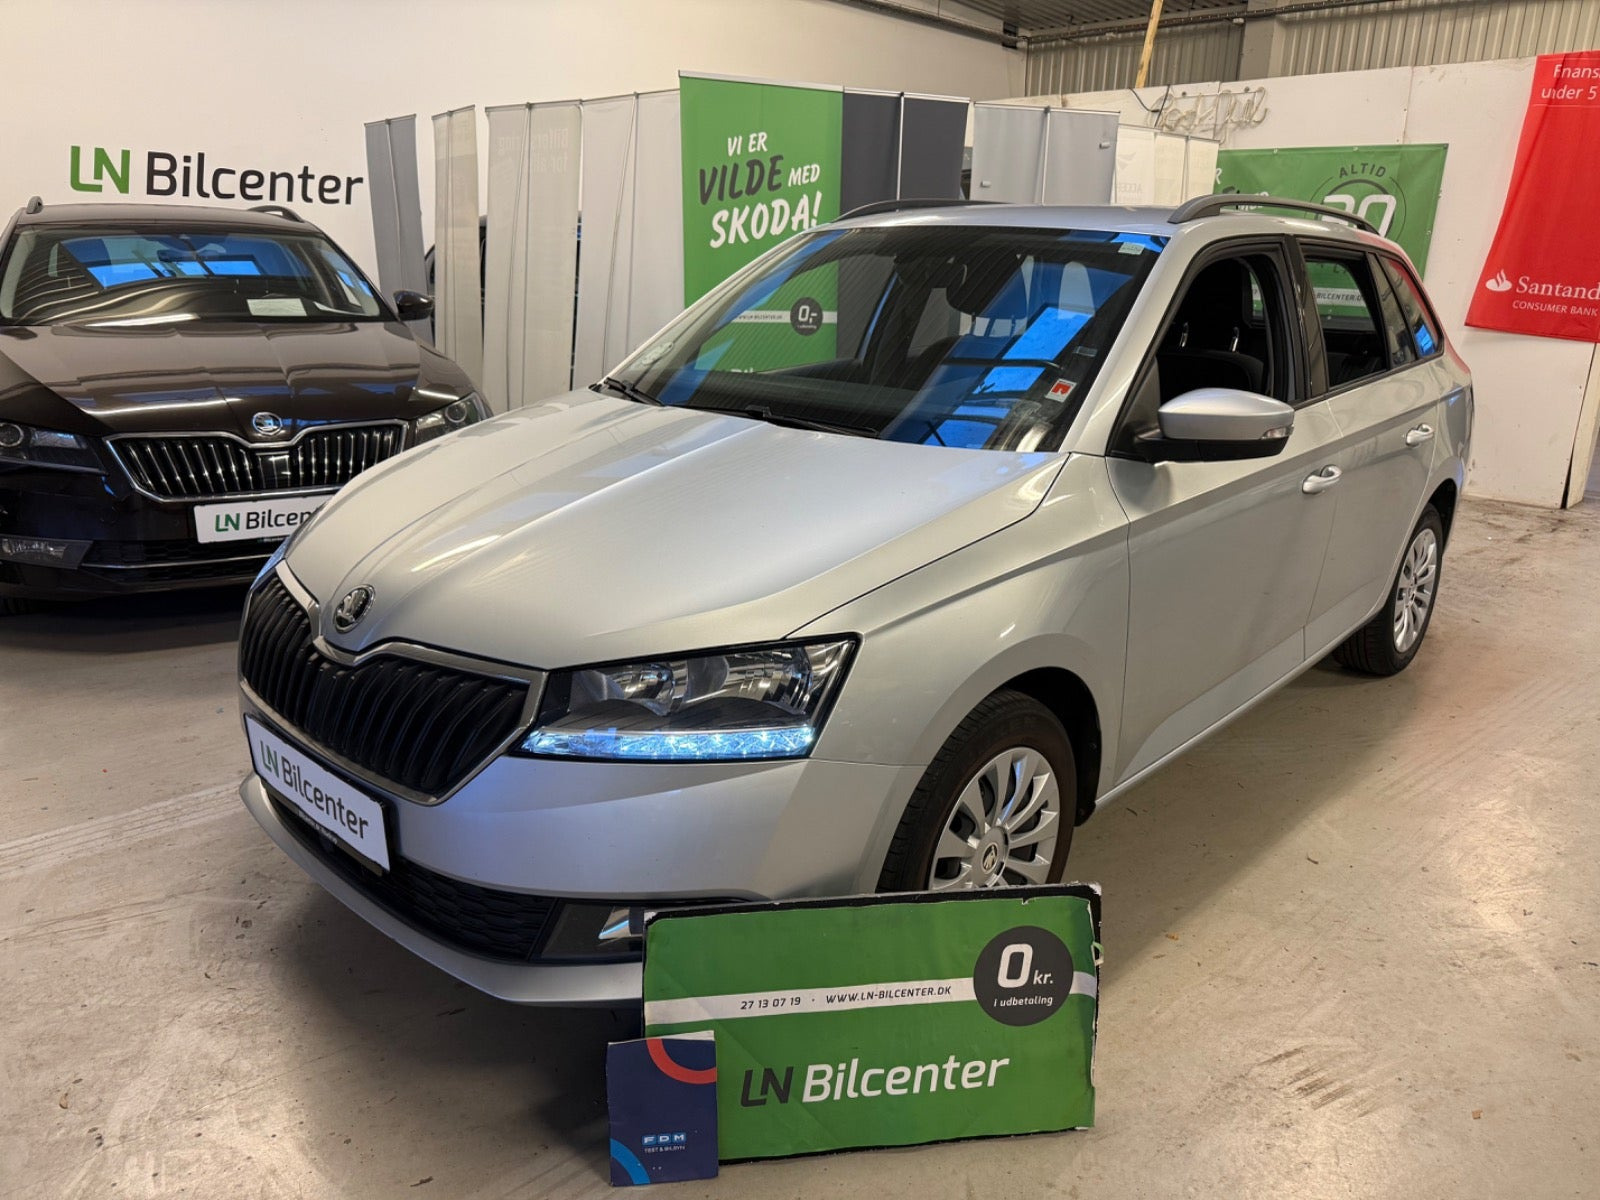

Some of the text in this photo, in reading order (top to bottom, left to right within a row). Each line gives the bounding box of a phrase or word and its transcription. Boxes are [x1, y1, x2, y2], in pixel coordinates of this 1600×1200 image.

[1553, 64, 1600, 79] Fnans
[1587, 85, 1598, 100] 5
[727, 131, 768, 157] VI ER
[70, 145, 364, 205] LN Bilcenter
[699, 155, 821, 206] VILDE MED
[1339, 162, 1387, 179] ALTID
[709, 190, 823, 248] SKODA!
[1516, 275, 1600, 300] Santand
[1512, 300, 1598, 317] CONSUMER BANK
[215, 509, 313, 532] LN Bilcen
[260, 740, 280, 778] LN
[281, 755, 369, 840] Bilcenter
[997, 943, 1054, 988] 0 kr.
[740, 986, 951, 1010] 27 13 07 19 WWW.LN-BILCENTER.DK
[1000, 996, 1053, 1007] udbetaling
[740, 1055, 1010, 1107] LN Bilcenter
